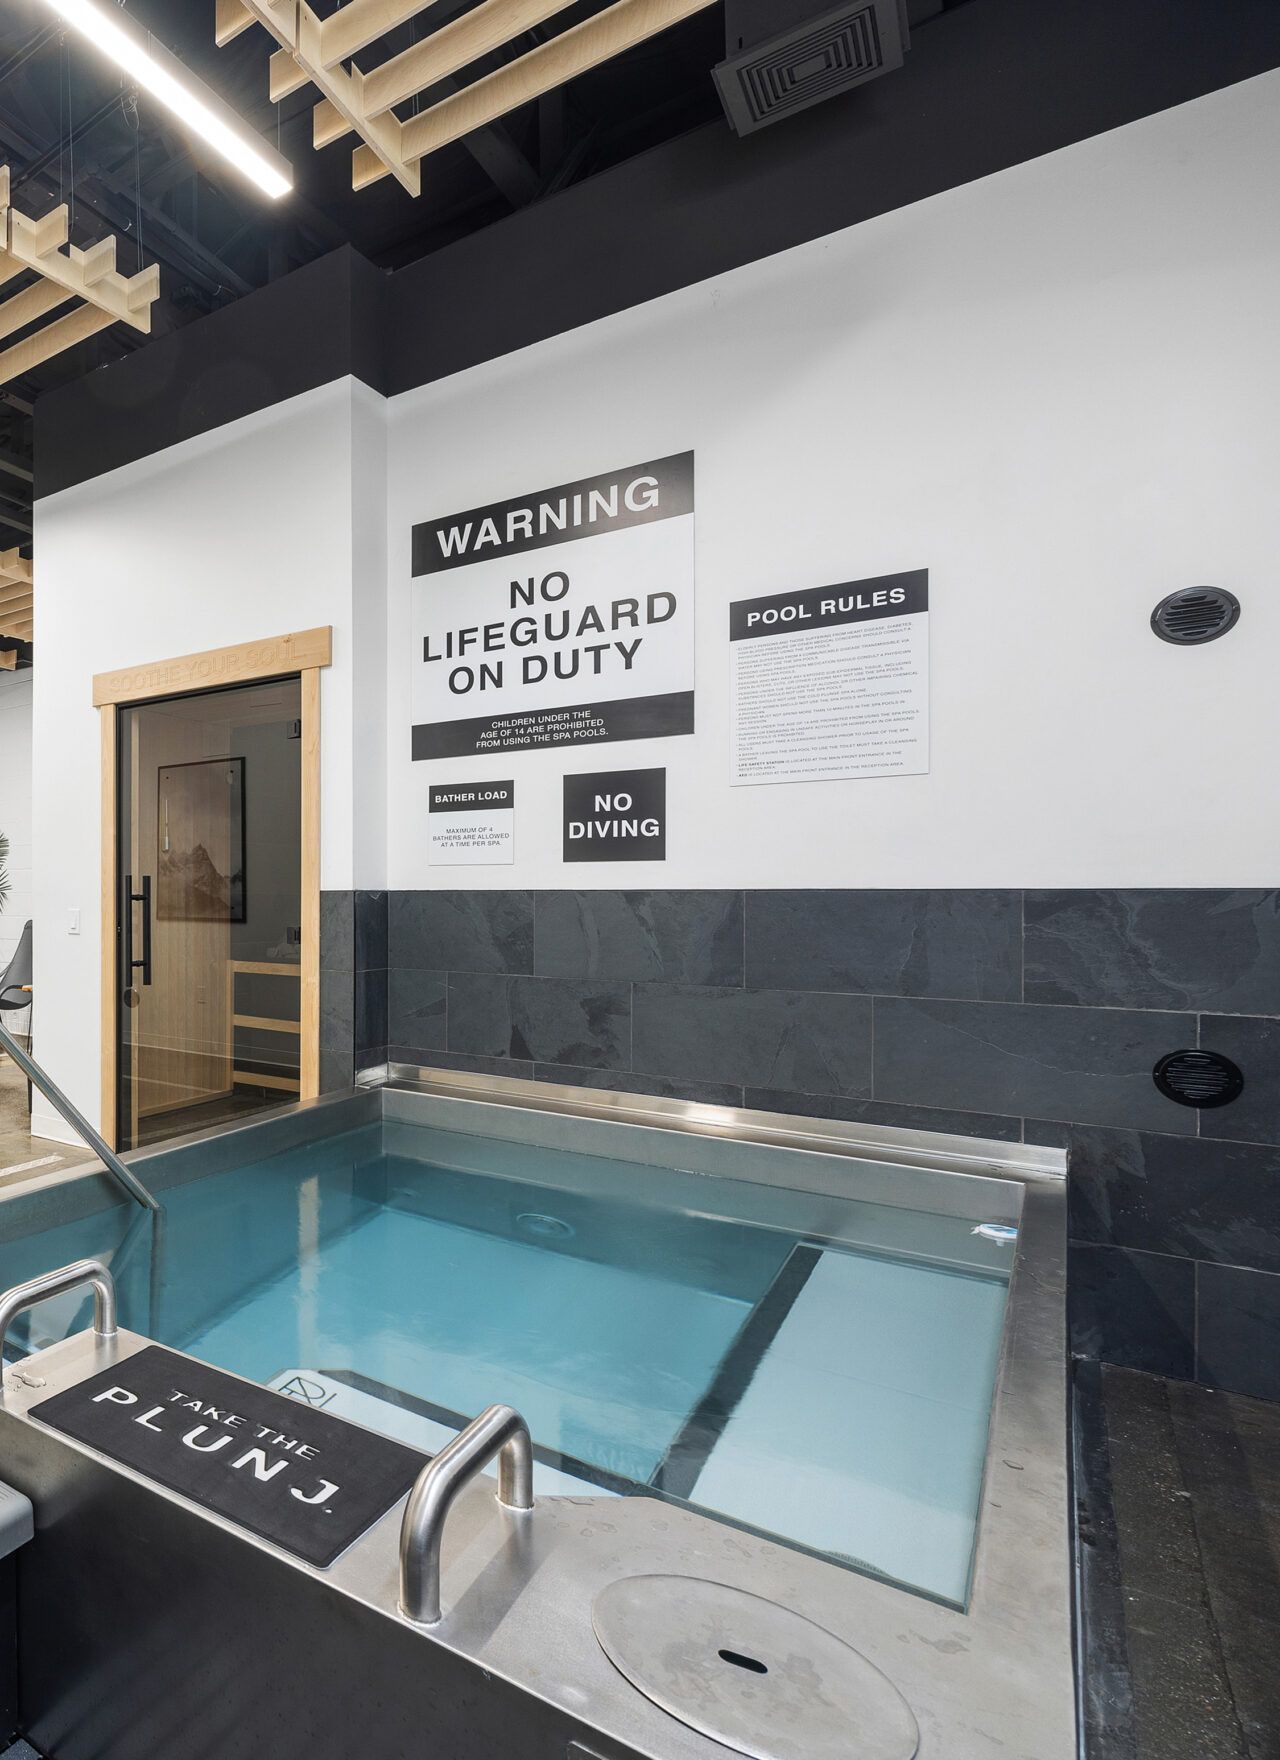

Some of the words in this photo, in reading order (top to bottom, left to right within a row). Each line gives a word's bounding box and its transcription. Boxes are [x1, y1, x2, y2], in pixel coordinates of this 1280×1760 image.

[437, 476, 661, 558] WARNING
[511, 572, 569, 609] NO
[748, 605, 811, 626] POOL
[821, 588, 905, 615] RULES
[424, 592, 676, 662] LIFEGUARD
[449, 661, 502, 694] ON
[523, 638, 642, 684] DUTY
[476, 739, 500, 748] FROM
[503, 736, 530, 746] USING
[553, 732, 571, 740] SPA
[574, 728, 609, 738] POOLS.
[480, 731, 497, 739] AGE
[527, 726, 545, 734] ARE
[547, 719, 604, 732] PROHIBITED
[492, 717, 535, 729] CHILDREN
[538, 713, 570, 724] UNDER
[572, 710, 591, 719] THE
[435, 793, 474, 803] BATHER
[479, 791, 507, 800] LOAD
[595, 794, 632, 811] NO
[569, 819, 659, 838] DIVING
[170, 1389, 246, 1428] TAKE
[257, 1425, 321, 1461] THE
[92, 1386, 340, 1514] PLUNJ.
